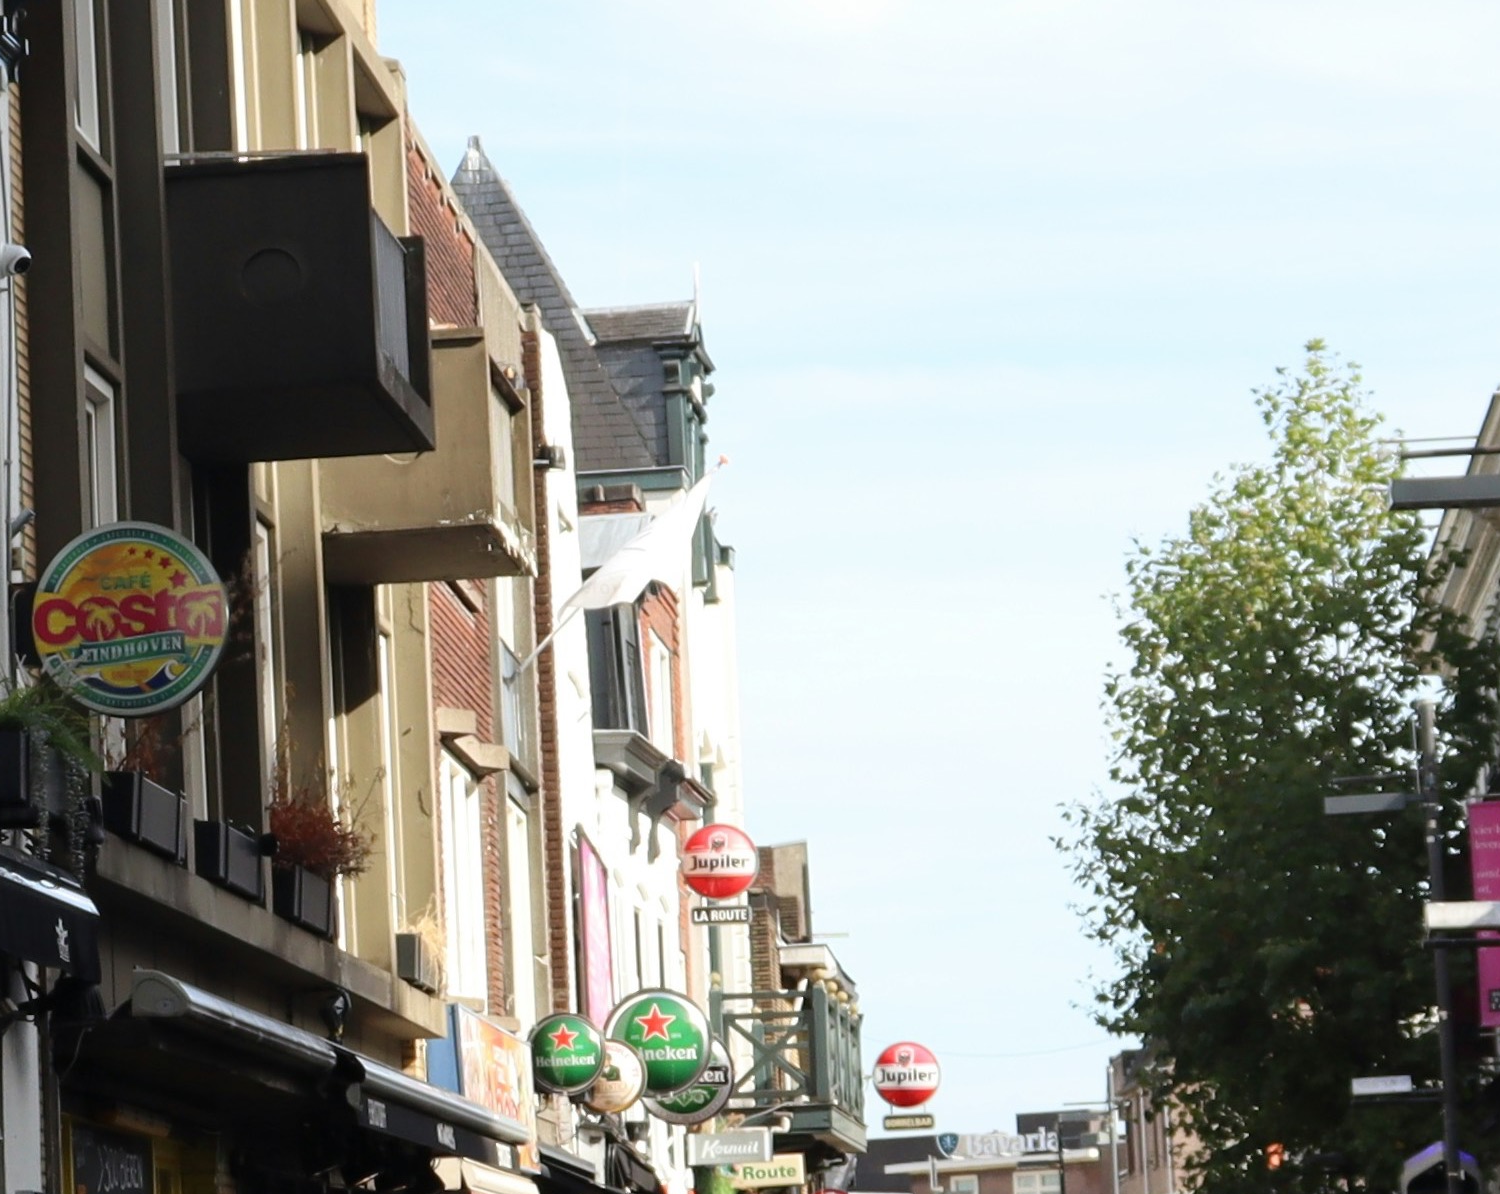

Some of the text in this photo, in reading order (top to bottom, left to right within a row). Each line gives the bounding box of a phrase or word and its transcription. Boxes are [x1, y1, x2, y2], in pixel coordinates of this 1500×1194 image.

[100, 573, 151, 590] CAFÉ
[82, 636, 182, 664] EINDHOVEN
[689, 854, 749, 872] Jupiler
[693, 909, 748, 922] LA ROUTE
[535, 1052, 596, 1068] Heineken
[639, 1043, 698, 1062] ineken
[877, 1067, 937, 1086] Jupiler
[967, 1126, 1059, 1155] Bavaria
[743, 1166, 797, 1181] Route
